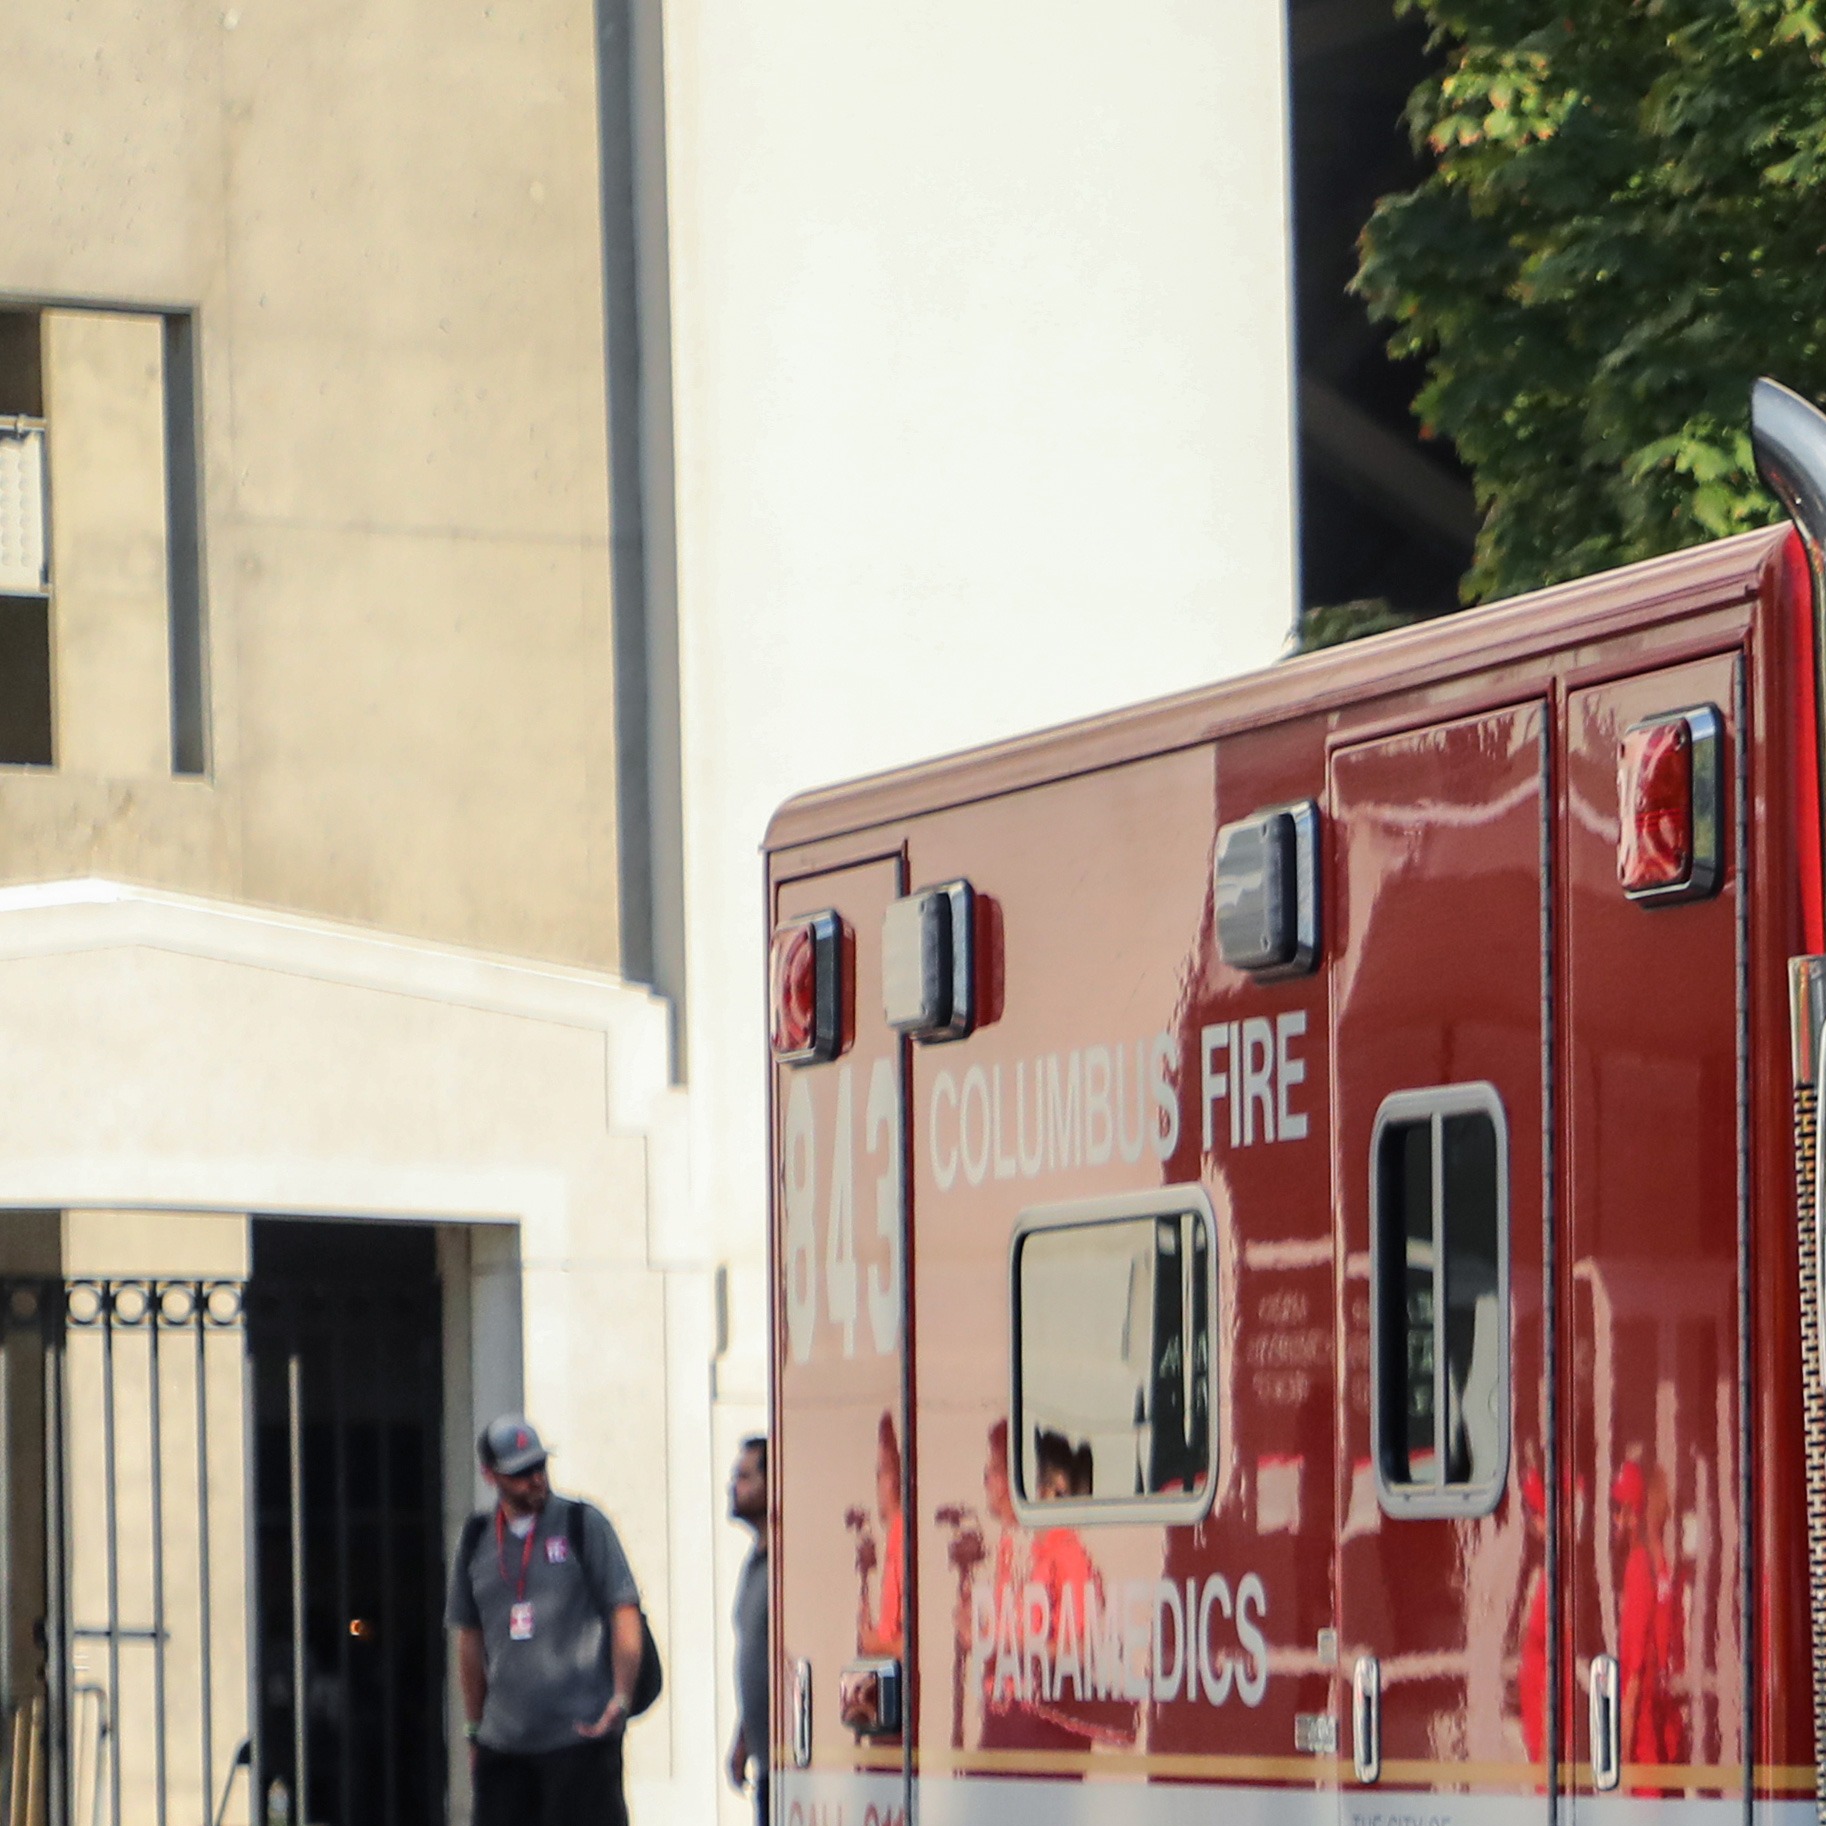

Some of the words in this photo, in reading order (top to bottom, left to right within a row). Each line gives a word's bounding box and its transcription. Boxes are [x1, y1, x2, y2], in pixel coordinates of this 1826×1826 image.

[928, 1031, 1181, 1191] COLUMBUS
[1201, 1009, 1309, 1153] FIRE
[785, 1057, 899, 1366] 843
[970, 1572, 1268, 1708] PARAMEDICS
